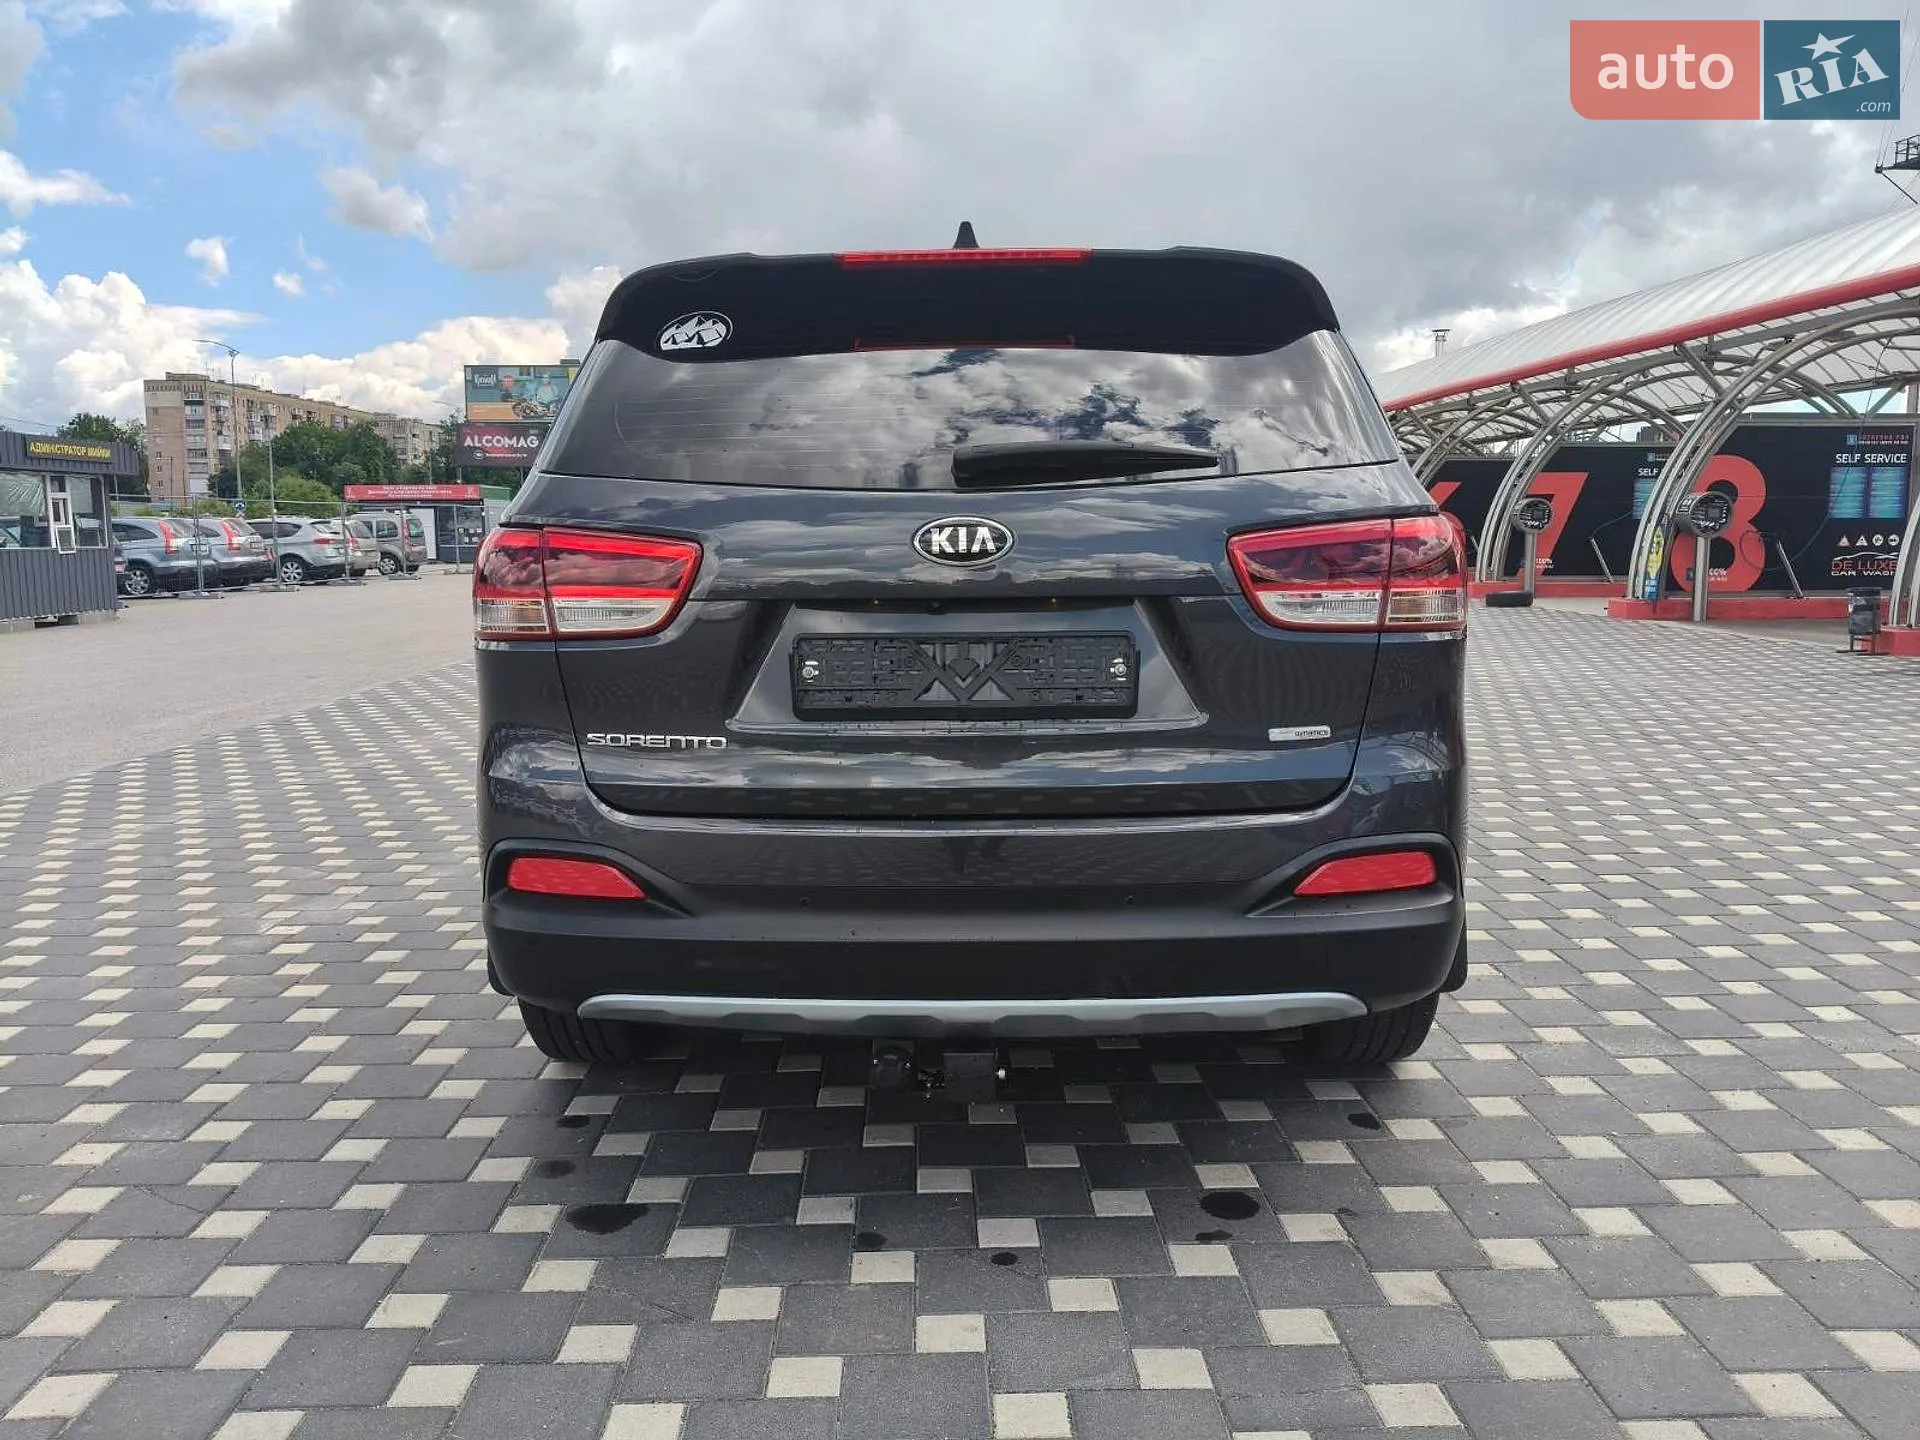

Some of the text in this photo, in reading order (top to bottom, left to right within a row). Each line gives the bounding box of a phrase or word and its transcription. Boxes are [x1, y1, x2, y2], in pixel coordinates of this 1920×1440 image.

[463, 435, 539, 448] ALCOMAG
[1835, 453, 1907, 464] SELF SERVICE
[1638, 467, 1659, 477] SELF
[1515, 471, 1589, 576] 7
[1671, 454, 1767, 592] 8
[930, 527, 997, 554] KIA
[1832, 561, 1898, 570] DE LUXE
[586, 733, 729, 749] SORENTO
